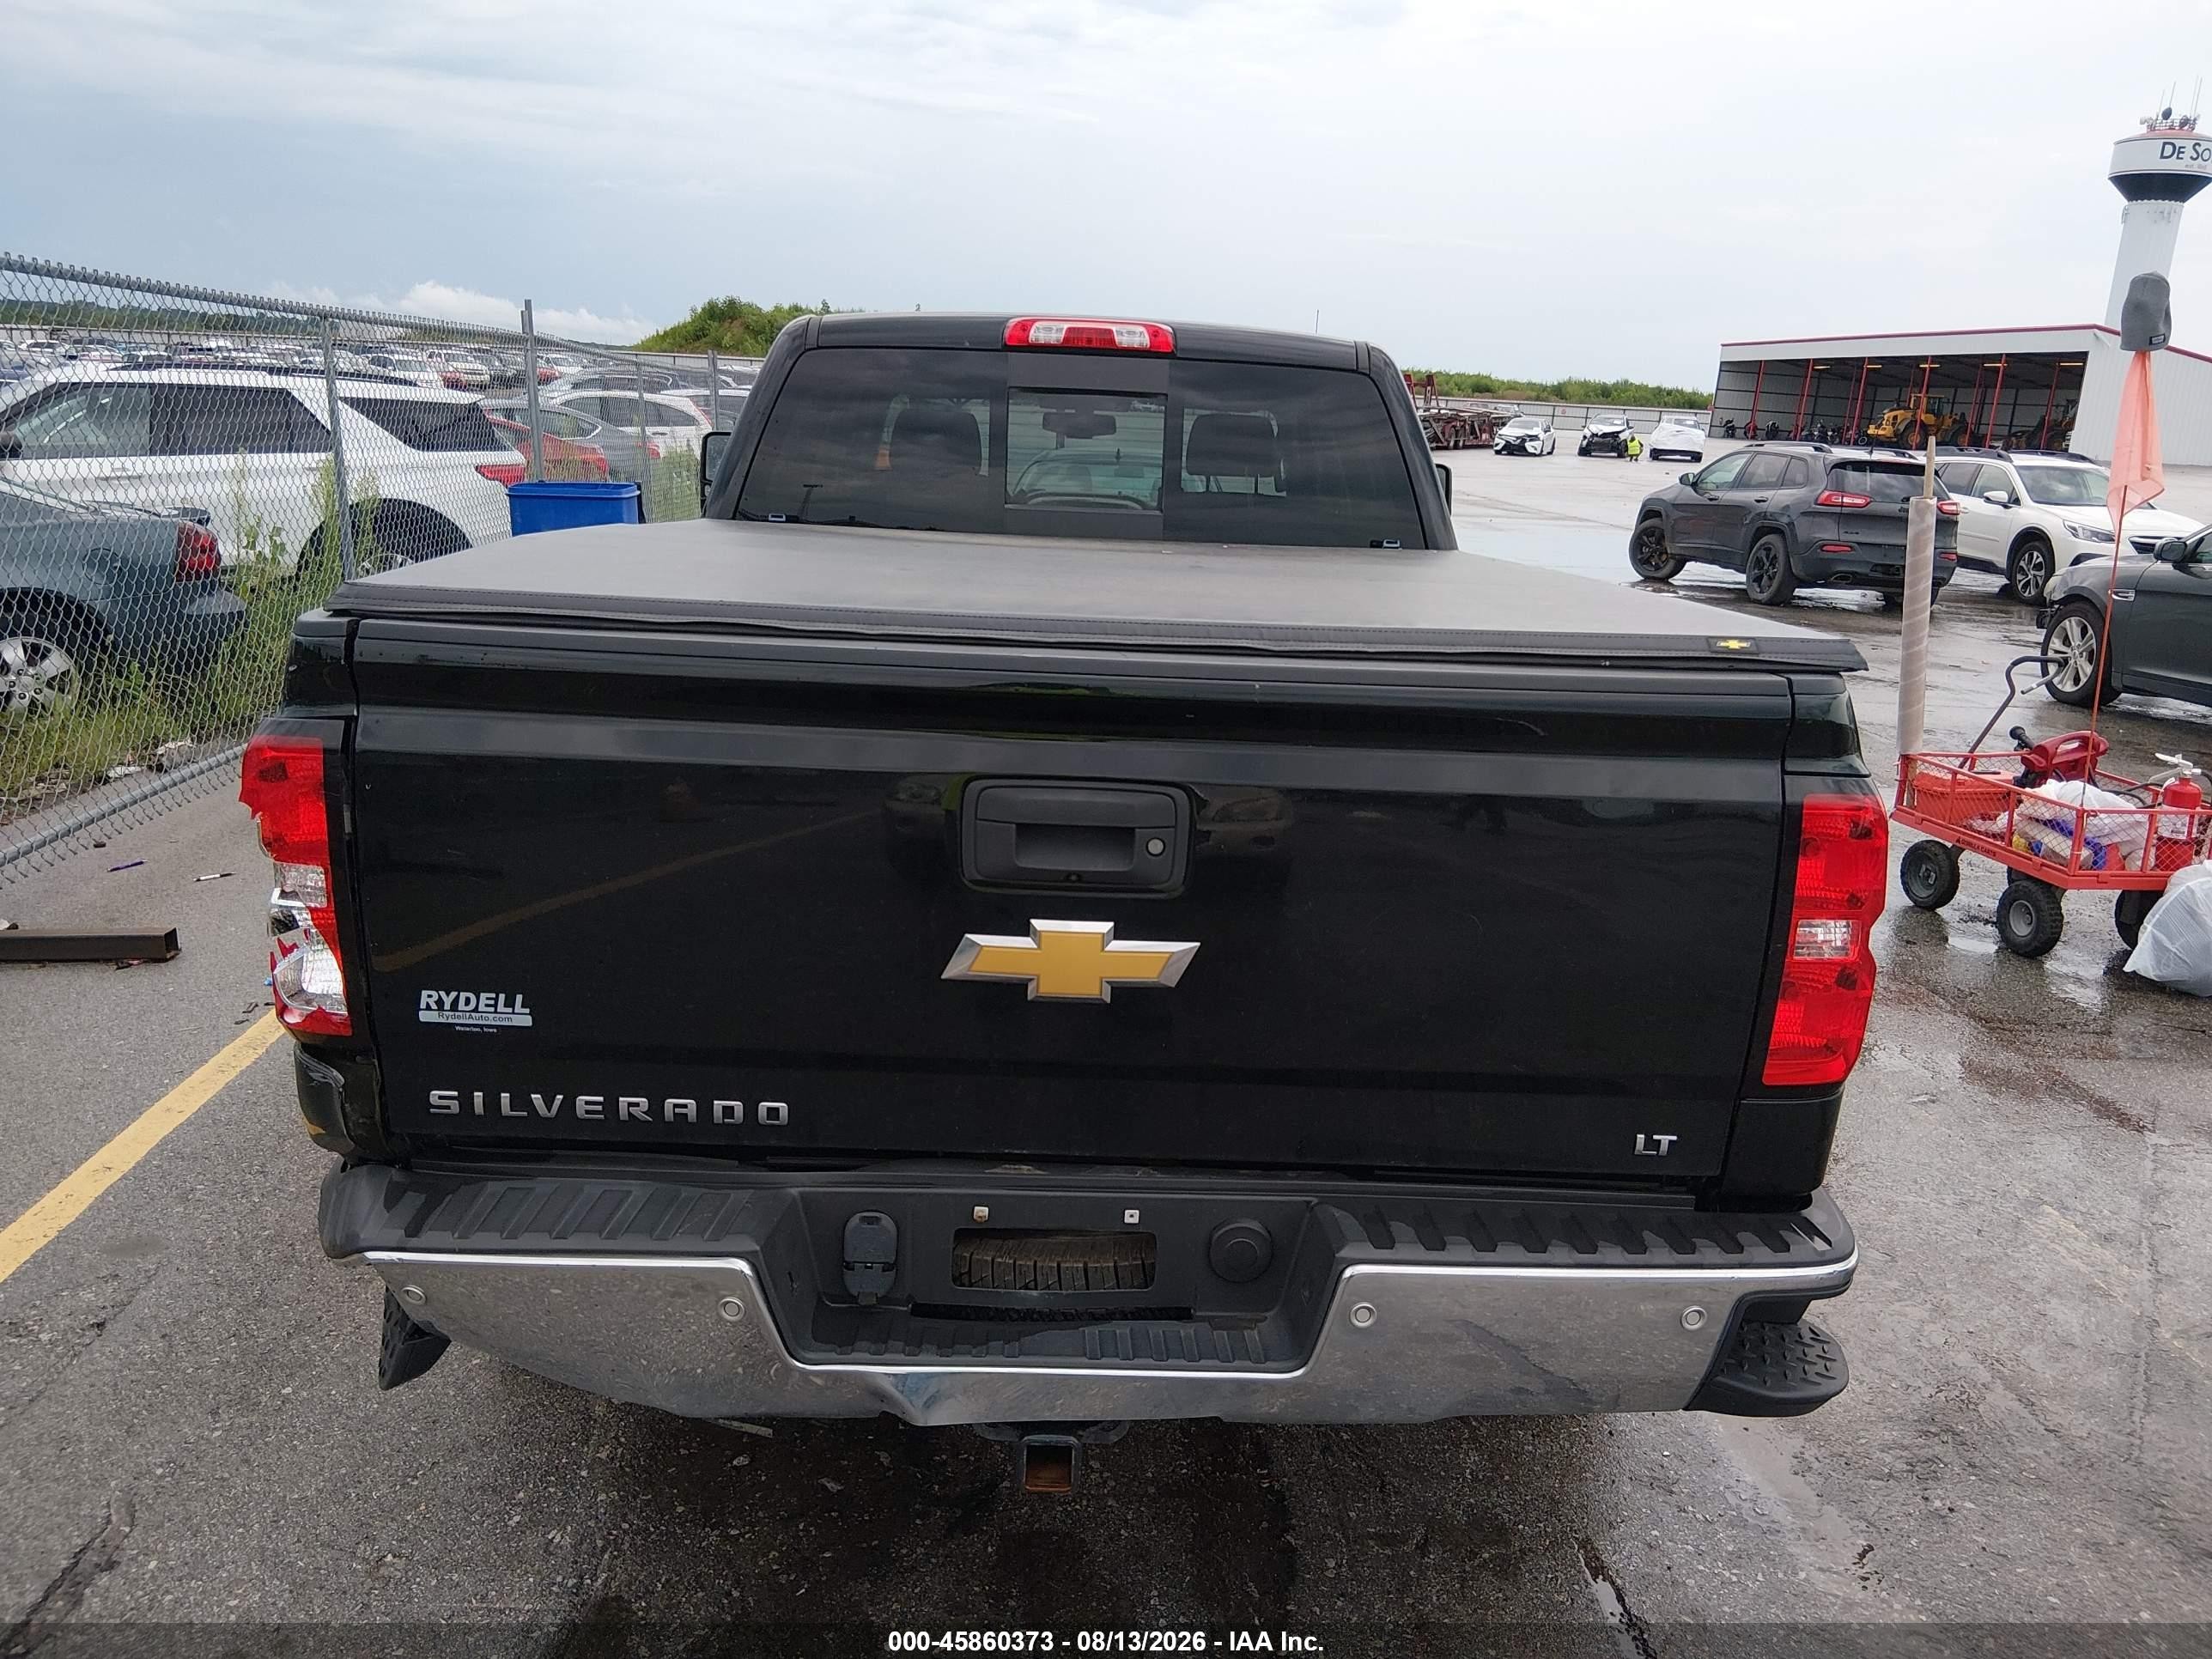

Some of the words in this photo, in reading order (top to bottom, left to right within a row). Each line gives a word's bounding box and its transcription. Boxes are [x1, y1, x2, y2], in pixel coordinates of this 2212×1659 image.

[2190, 142, 2212, 162] SO
[420, 989, 531, 1014] RYDELL
[437, 1012, 514, 1023] RydellAuto.com
[429, 1090, 789, 1126] SILVERADO
[1634, 1133, 1677, 1156] LT
